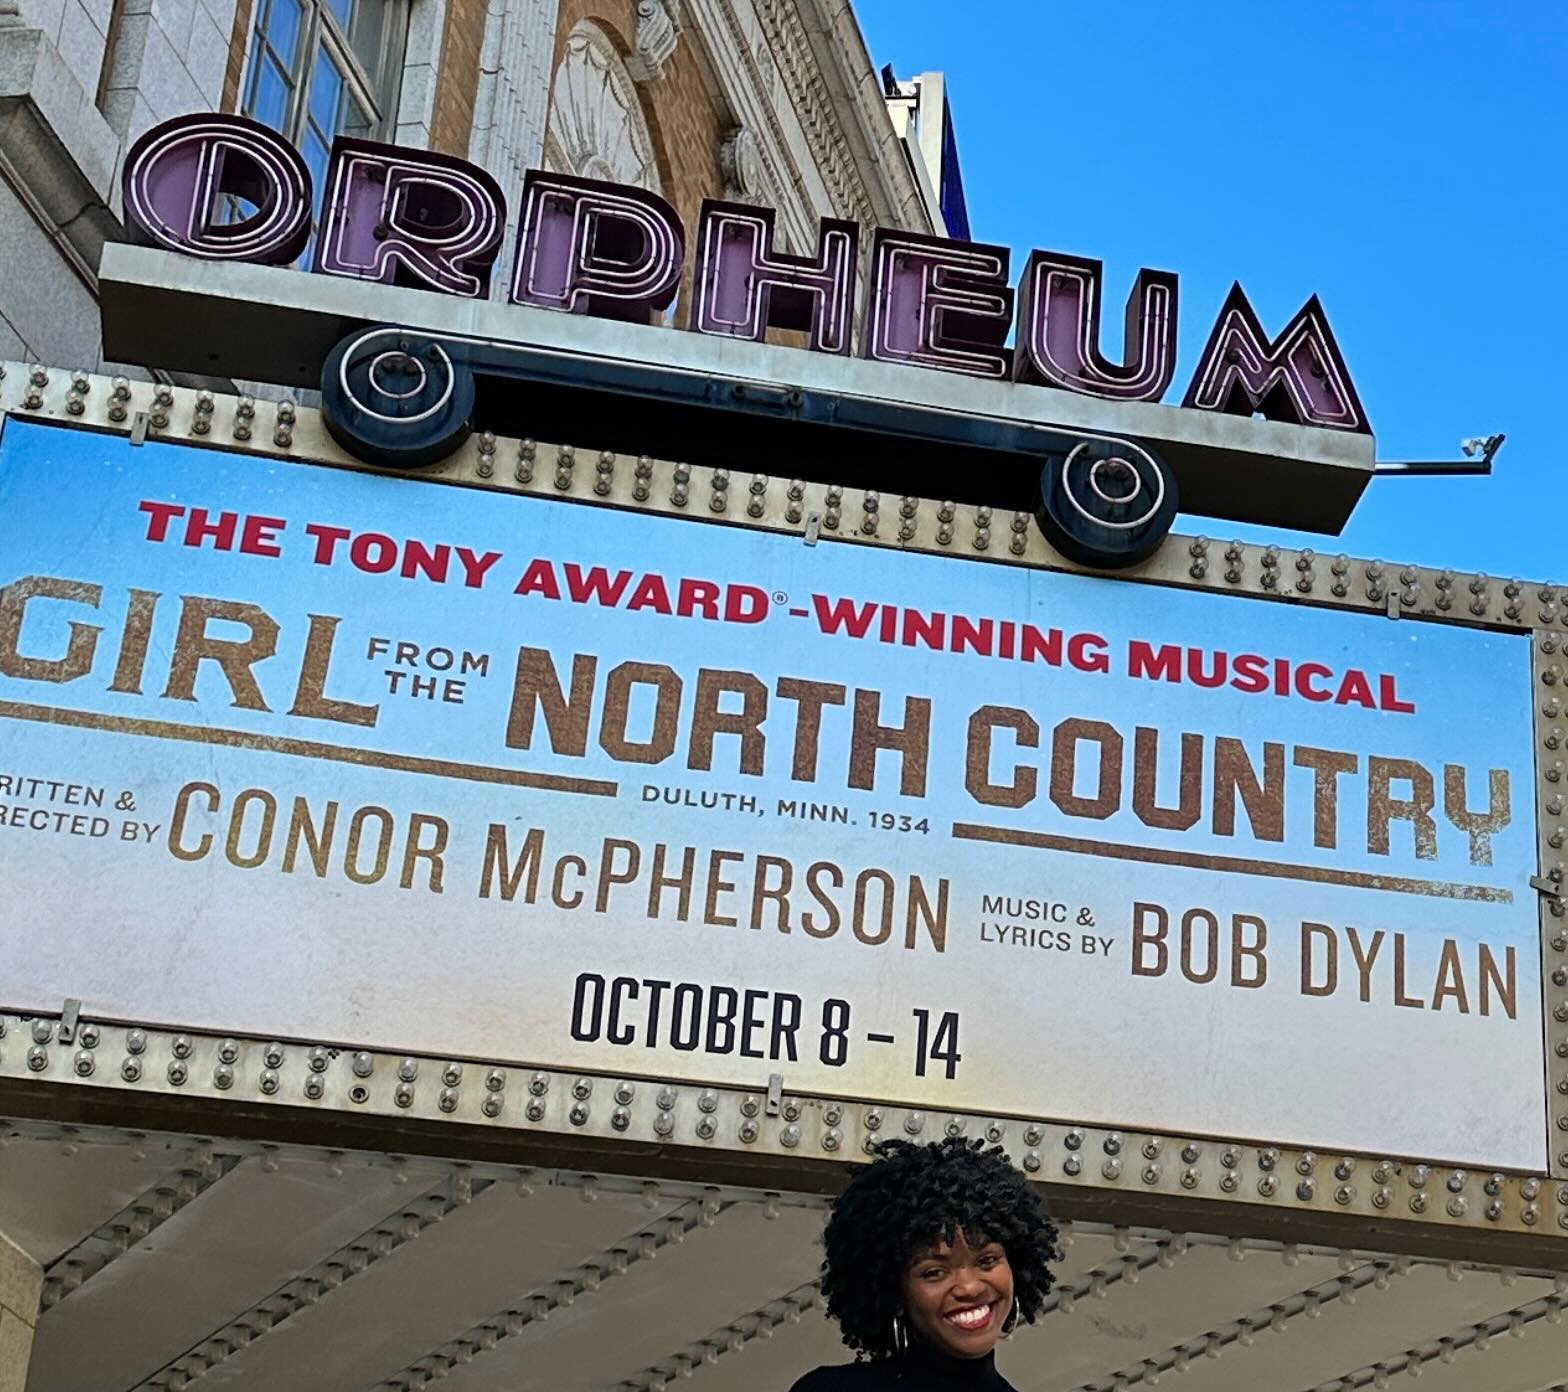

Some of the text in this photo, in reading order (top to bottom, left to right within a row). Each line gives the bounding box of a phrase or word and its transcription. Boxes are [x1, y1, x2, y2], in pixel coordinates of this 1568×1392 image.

[121, 112, 1375, 436] ORPHEUM
[138, 501, 286, 558] THE
[305, 524, 502, 589] TONY
[1127, 641, 1415, 715] MUSICAL
[0, 575, 380, 729] GIRL
[366, 637, 490, 677] FROM
[384, 670, 465, 704] THE
[505, 646, 1511, 867] NORTH COUNTRY
[115, 791, 136, 811] &
[120, 821, 160, 843] BY
[642, 785, 930, 835] DULUTH, MINN. 1934
[167, 780, 950, 954] CONOR McPHERSON
[979, 922, 1115, 957] LYRICS BY
[981, 895, 1096, 927] MUSIC &
[1131, 901, 1517, 1021] BOB DYLAN
[570, 972, 800, 1062] OCTOBER
[819, 998, 850, 1067] 8
[912, 1009, 962, 1080] 14
